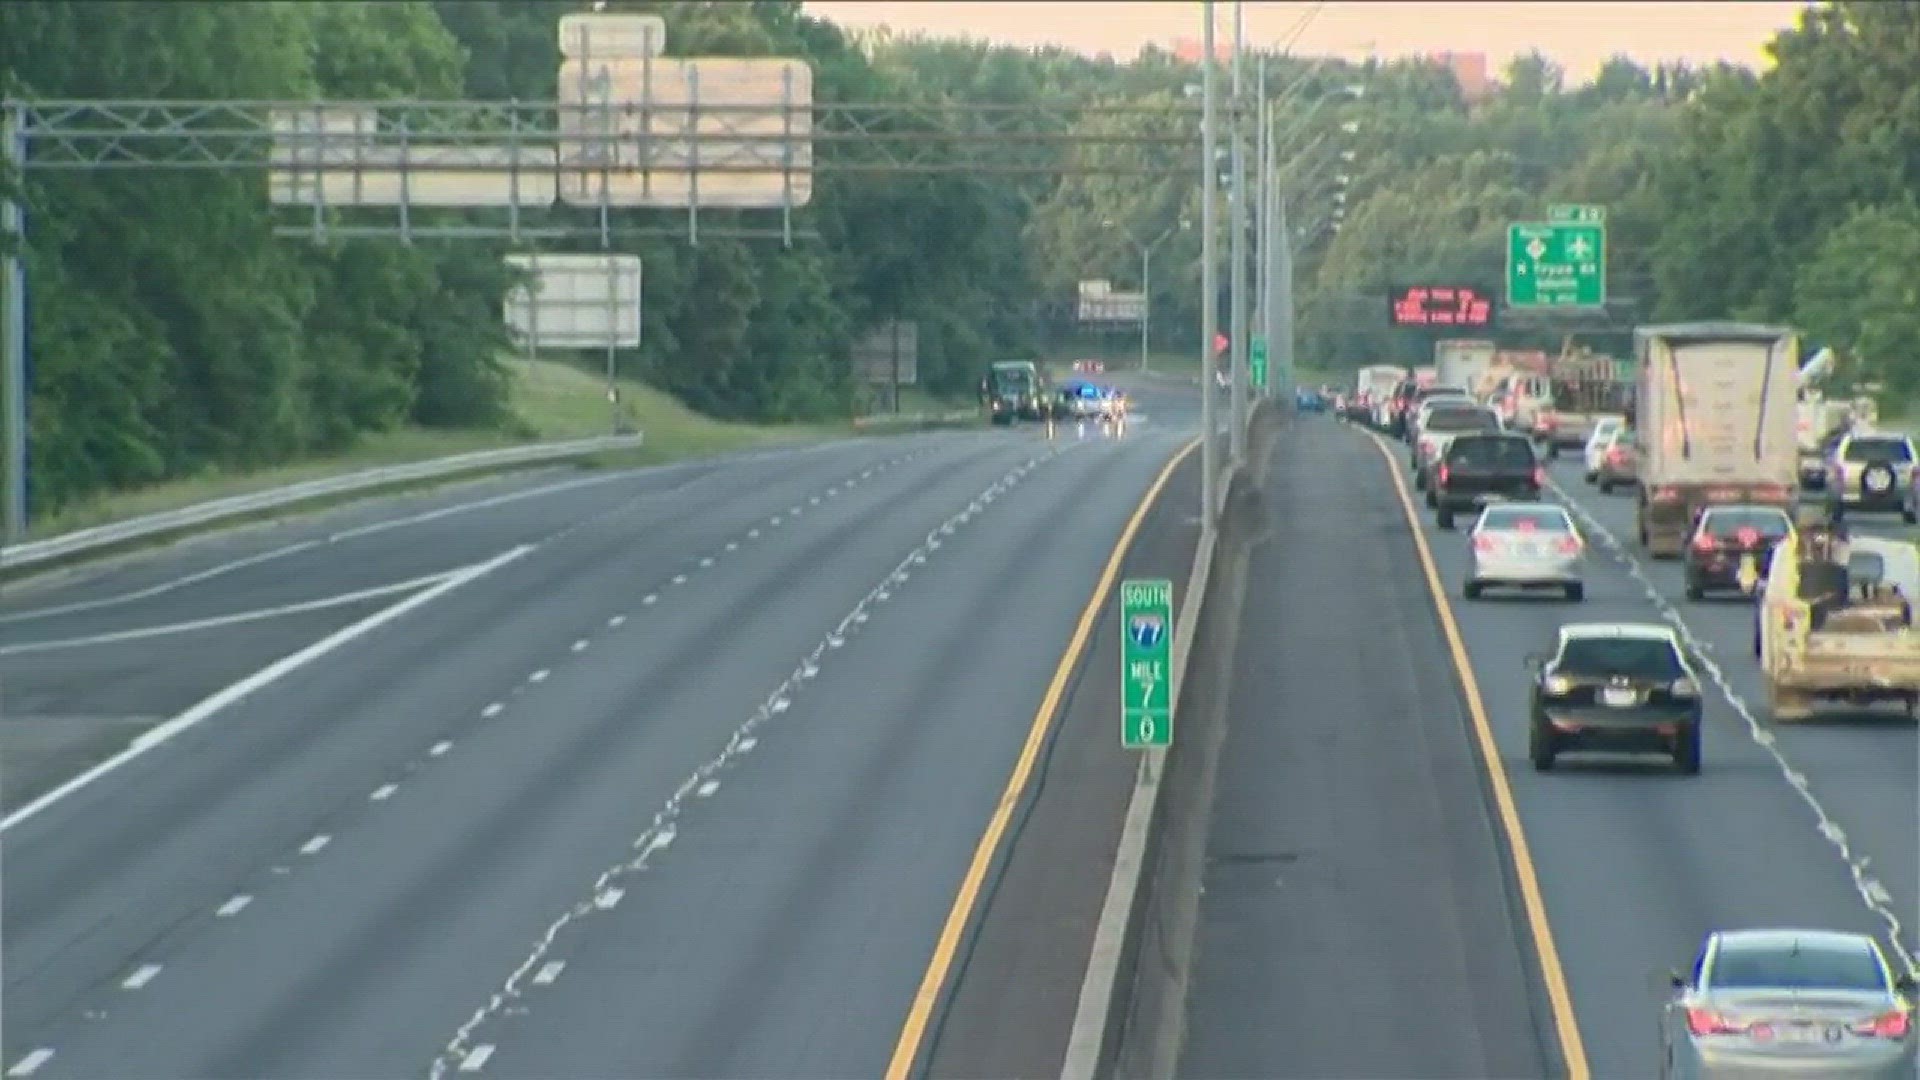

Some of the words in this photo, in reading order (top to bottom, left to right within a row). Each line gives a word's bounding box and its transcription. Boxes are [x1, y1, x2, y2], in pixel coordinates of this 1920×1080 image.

[1125, 586, 1169, 607] SOUTH
[1133, 618, 1161, 644] 77
[1131, 660, 1162, 681] MILE
[1141, 681, 1154, 708] 7
